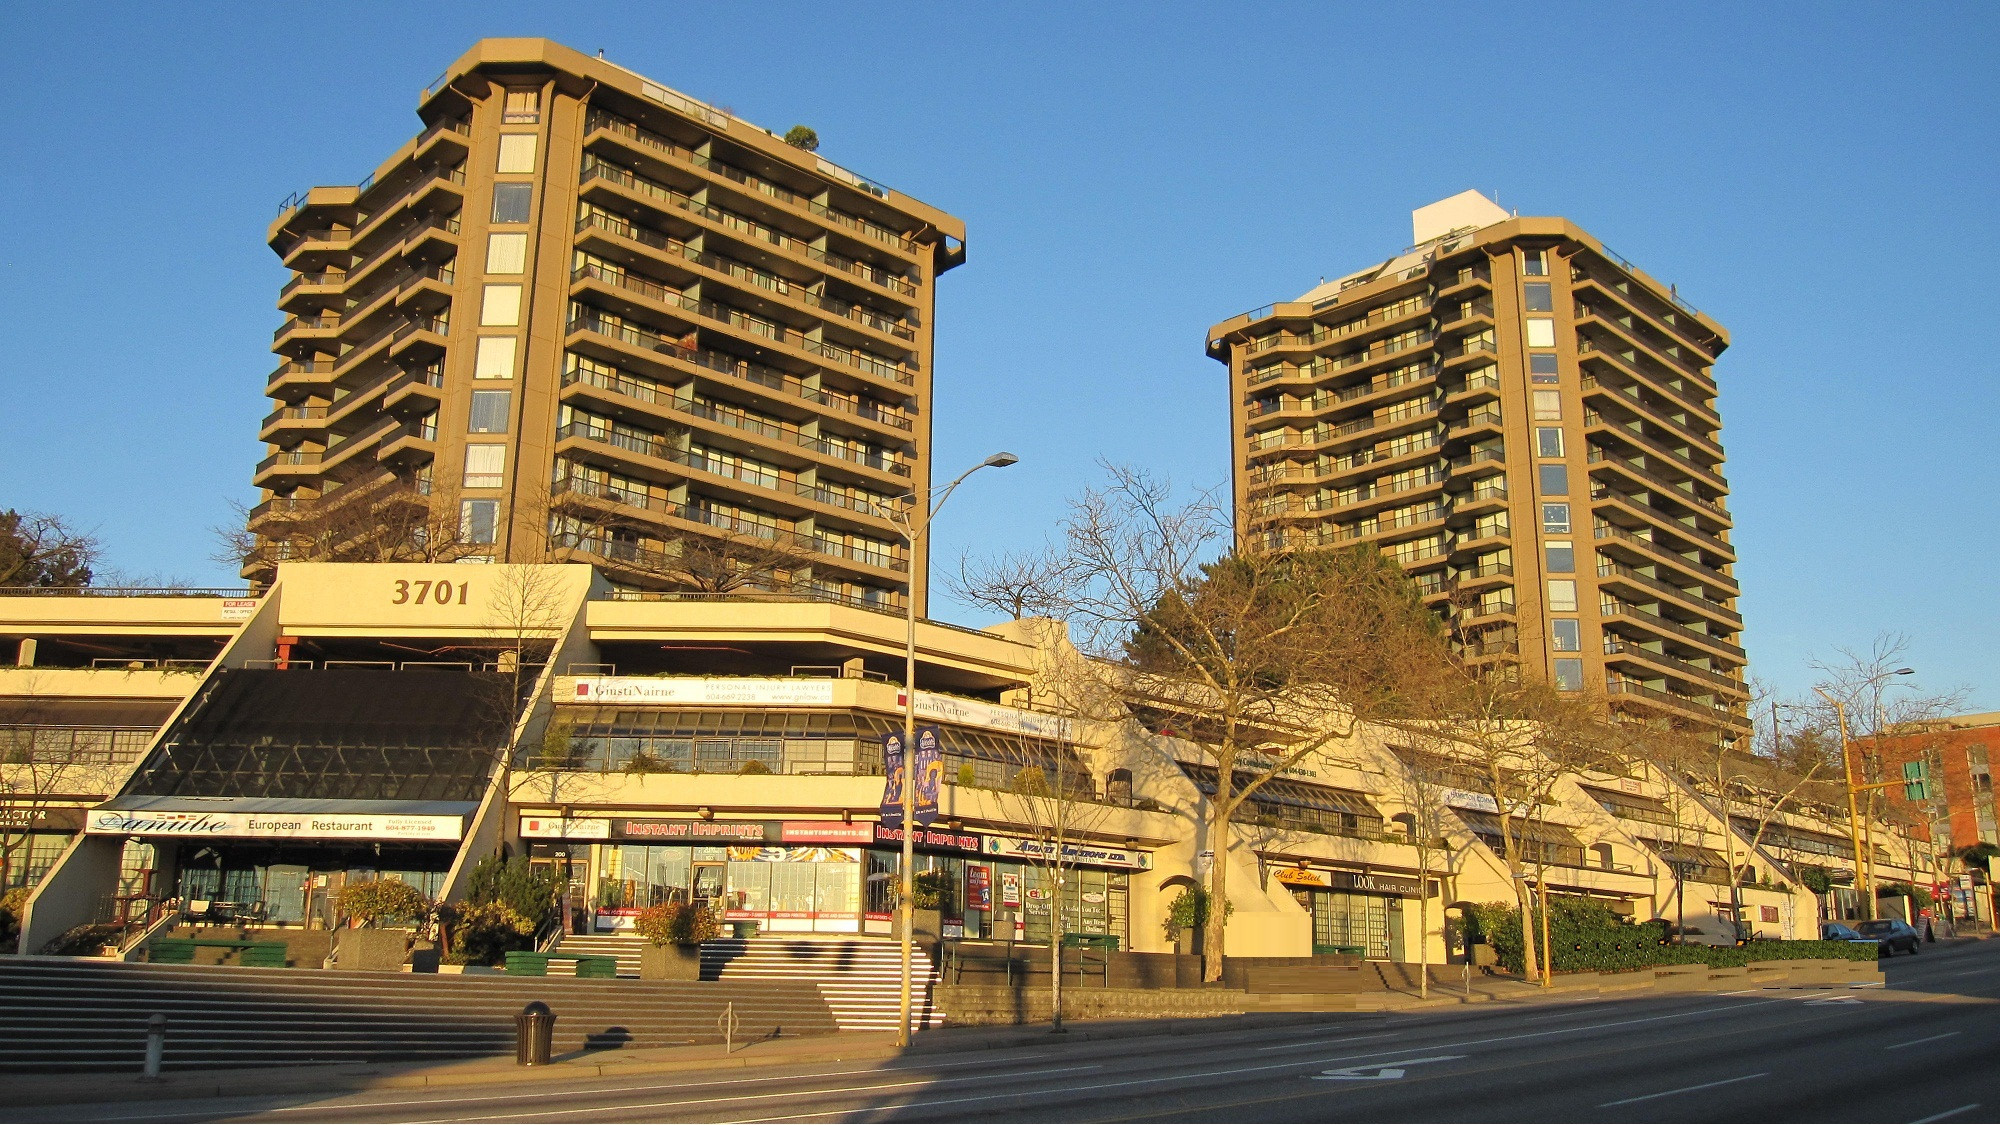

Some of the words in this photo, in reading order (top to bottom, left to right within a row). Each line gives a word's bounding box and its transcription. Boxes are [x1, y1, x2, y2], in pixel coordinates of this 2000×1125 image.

[392, 579, 468, 605] 3701
[595, 684, 675, 697] GiustiNairne
[791, 684, 831, 692] LAWYERS
[990, 709, 1019, 720] PERSONA
[89, 812, 226, 832] Danube
[249, 819, 301, 832] European
[311, 820, 373, 831] Restaurant
[626, 822, 687, 835] INSTANT
[692, 822, 764, 836] IMPRINTS
[876, 824, 923, 843] INSTNT
[969, 868, 987, 879] team
[1273, 870, 1293, 879] Club
[1296, 872, 1321, 882] Soleil
[1353, 874, 1375, 890] LOOK
